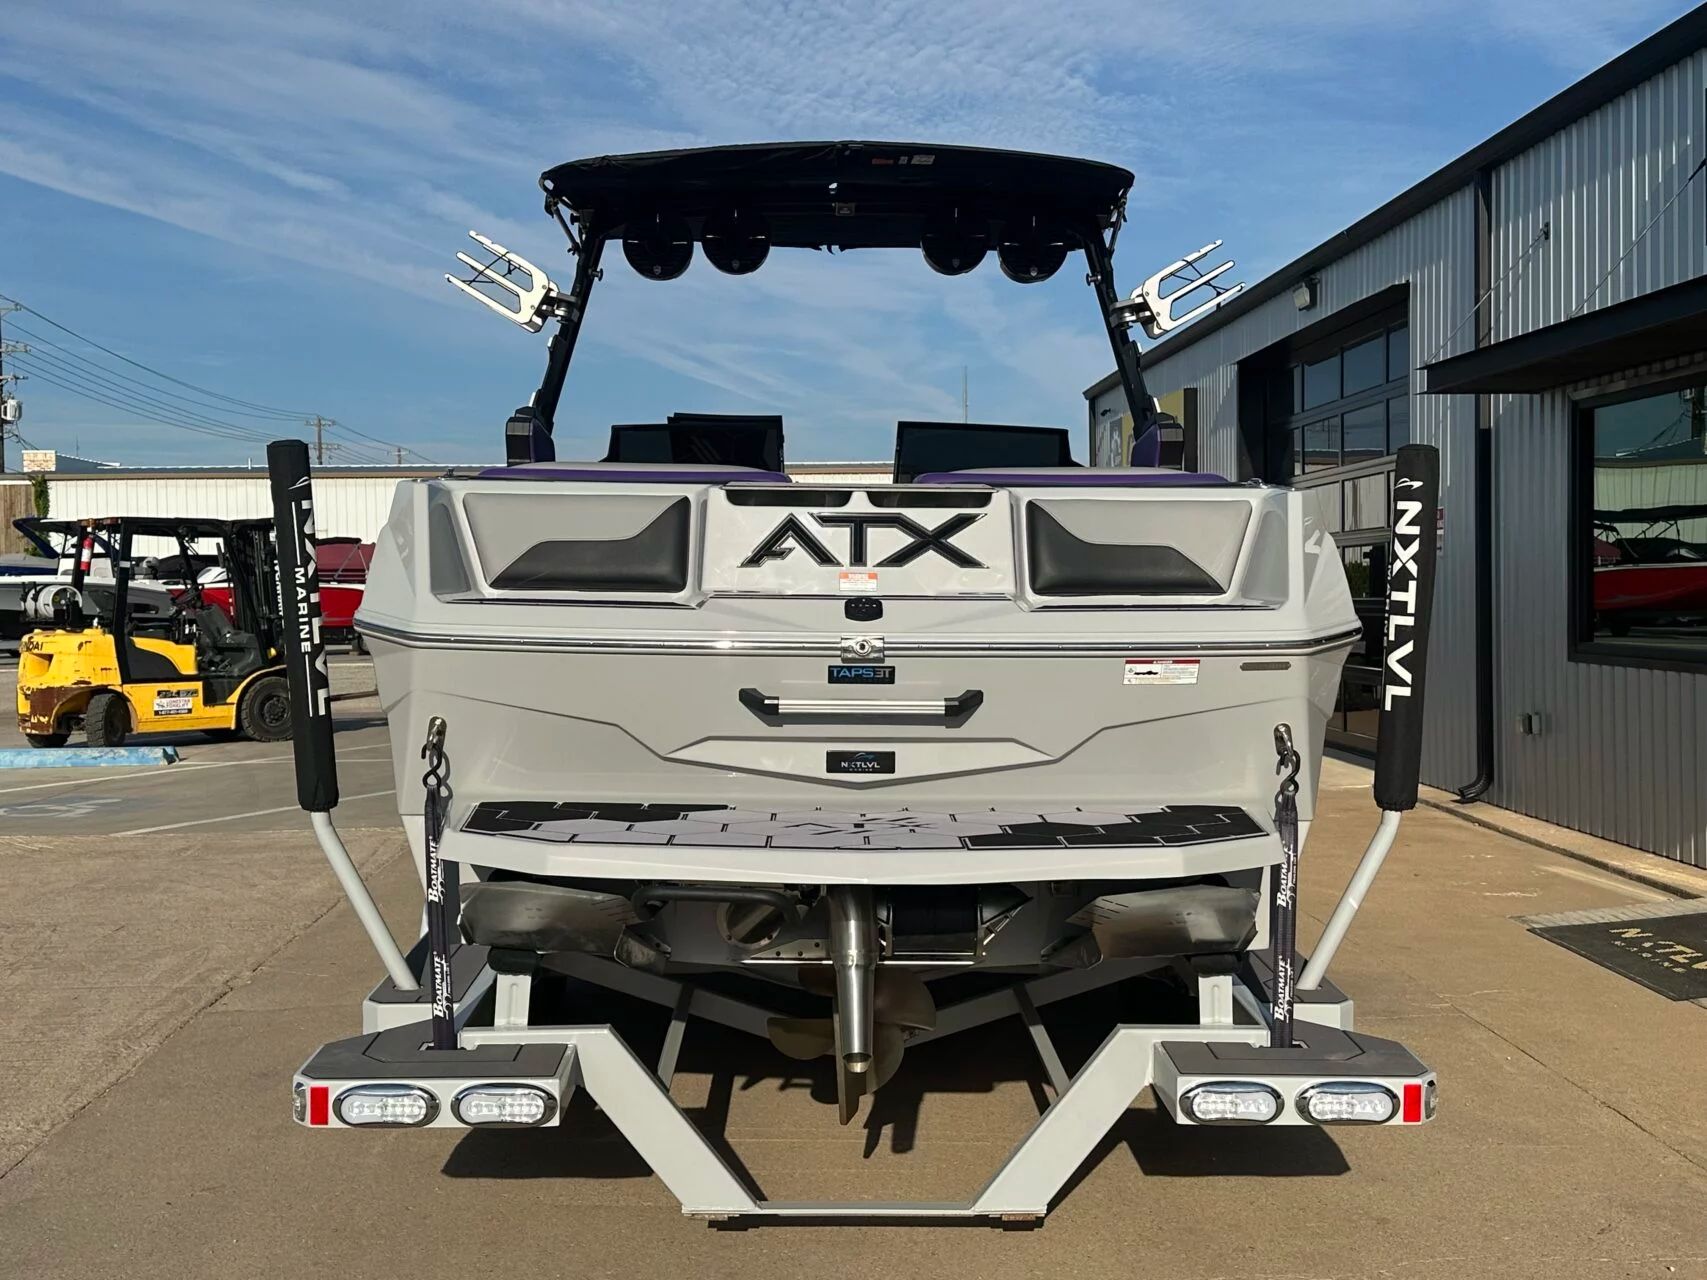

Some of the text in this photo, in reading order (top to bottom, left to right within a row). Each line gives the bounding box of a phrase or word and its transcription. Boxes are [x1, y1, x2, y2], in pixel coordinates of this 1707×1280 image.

[737, 511, 990, 568] ATX
[295, 567, 311, 653] MARINE
[1385, 501, 1422, 711] NXTLVL
[841, 761, 880, 769] NXTLVL
[433, 955, 444, 1018] BOATMATE
[1274, 960, 1285, 1020] BOATMATE
